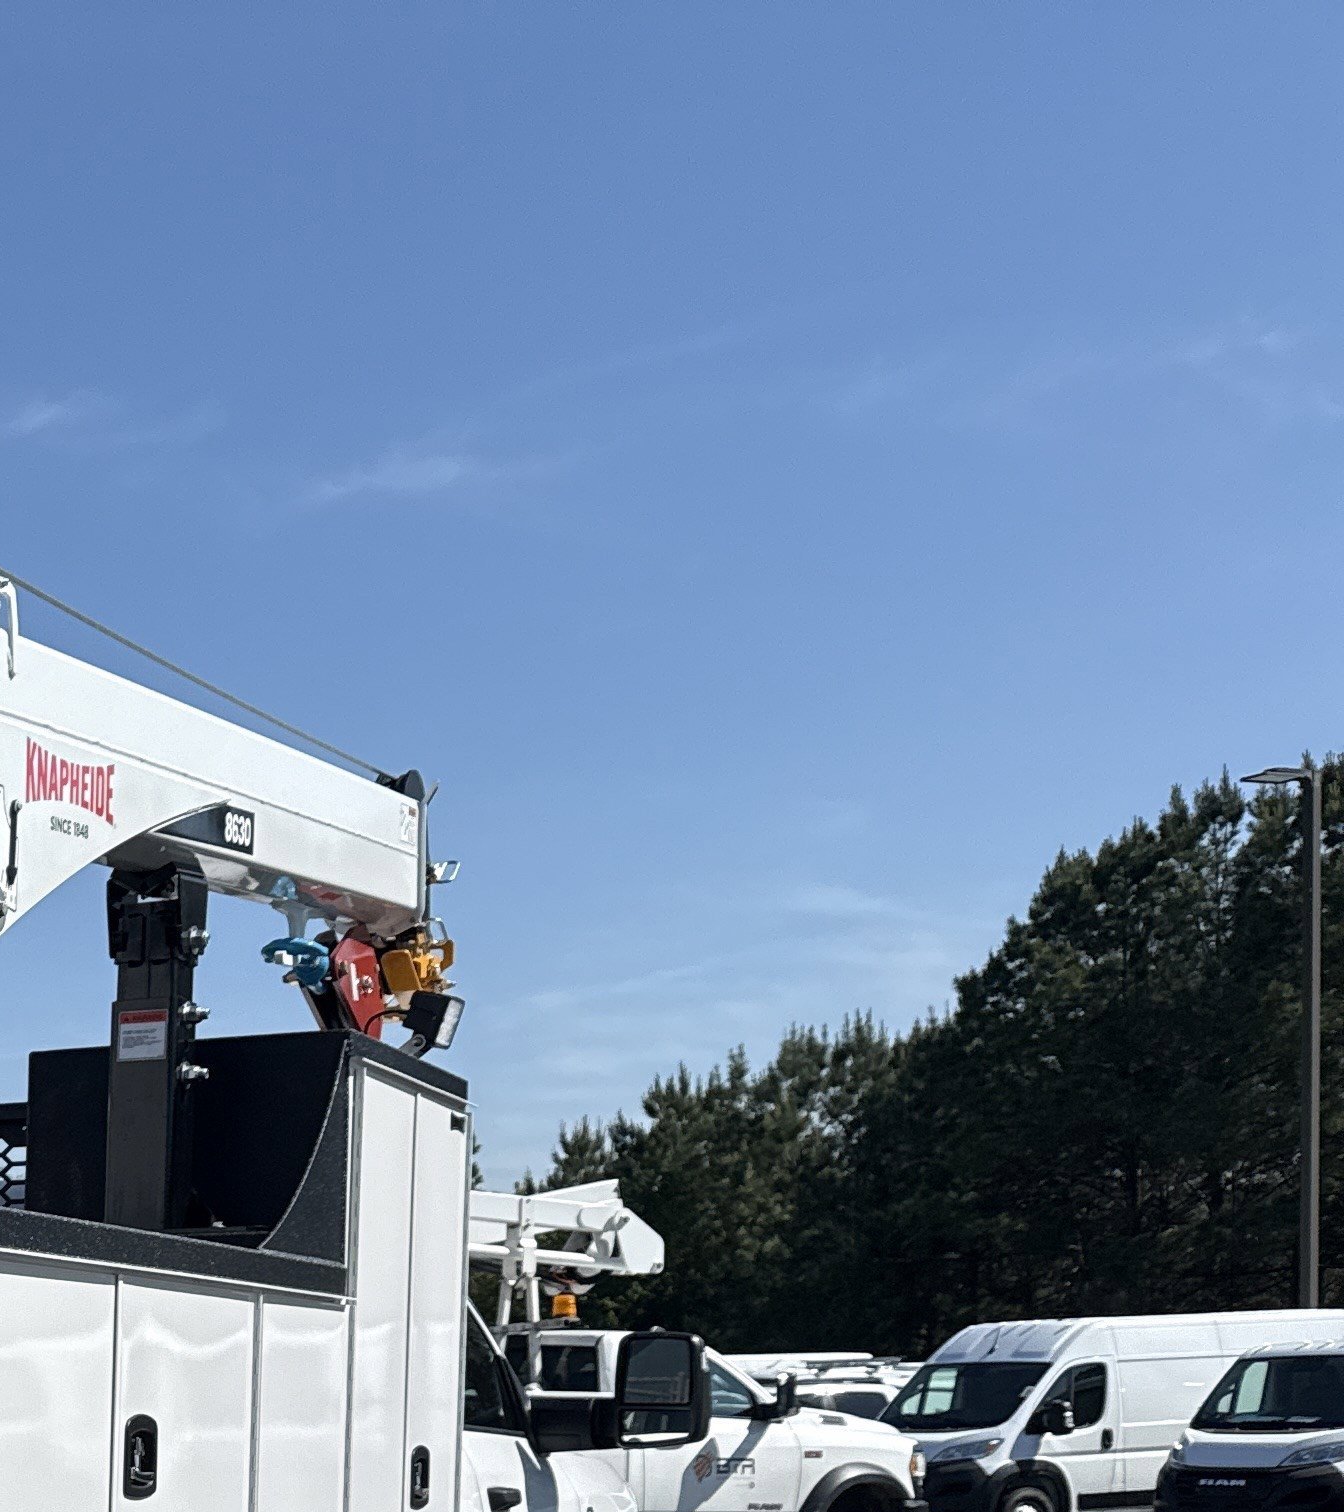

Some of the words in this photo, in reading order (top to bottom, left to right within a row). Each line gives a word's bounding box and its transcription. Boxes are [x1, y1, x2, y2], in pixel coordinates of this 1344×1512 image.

[25, 736, 115, 827] KNAPHEIDE
[50, 815, 72, 835] SINCE
[224, 811, 252, 847] 8630
